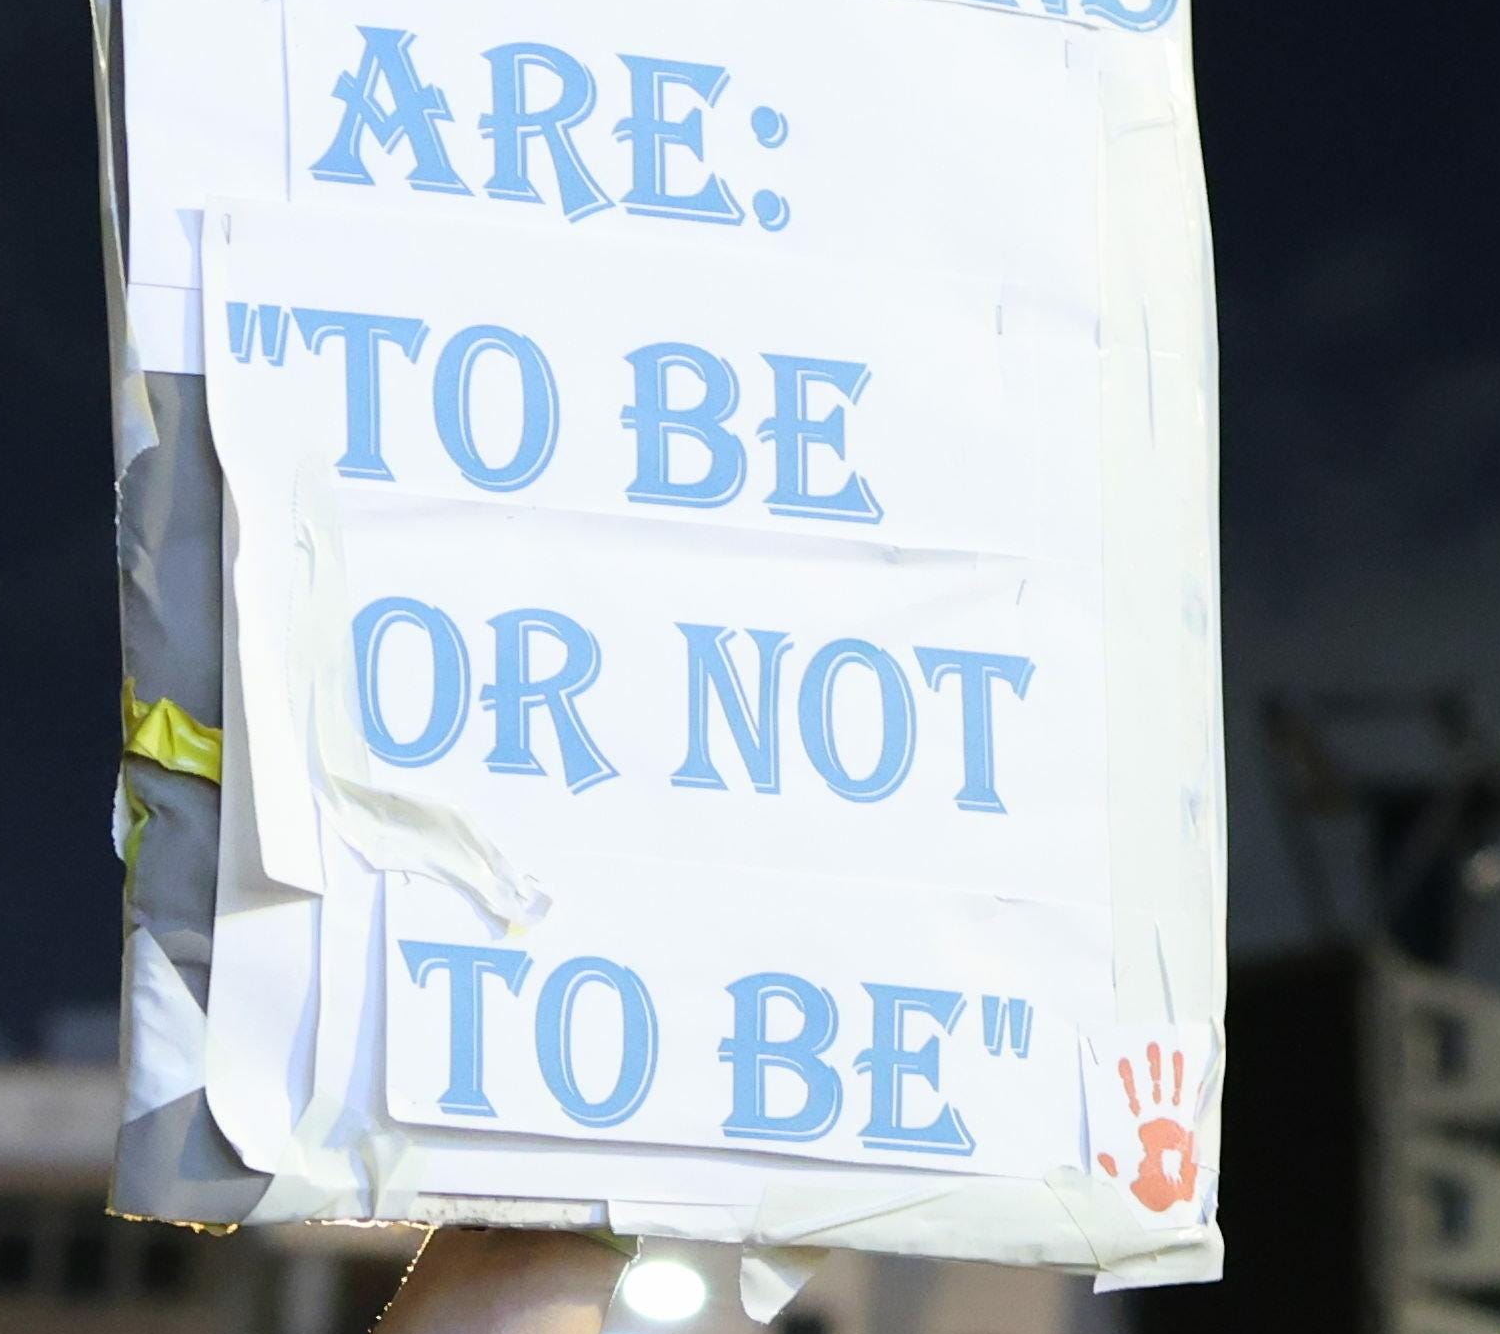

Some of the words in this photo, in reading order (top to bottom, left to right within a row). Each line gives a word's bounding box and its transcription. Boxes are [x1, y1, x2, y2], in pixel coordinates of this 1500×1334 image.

[309, 25, 792, 232] ARE:
[225, 301, 561, 493] "TO
[619, 341, 886, 526] BE
[350, 596, 619, 796] OR
[670, 620, 1036, 815] NOT
[398, 938, 659, 1129] TO
[717, 971, 1035, 1157] BE"
